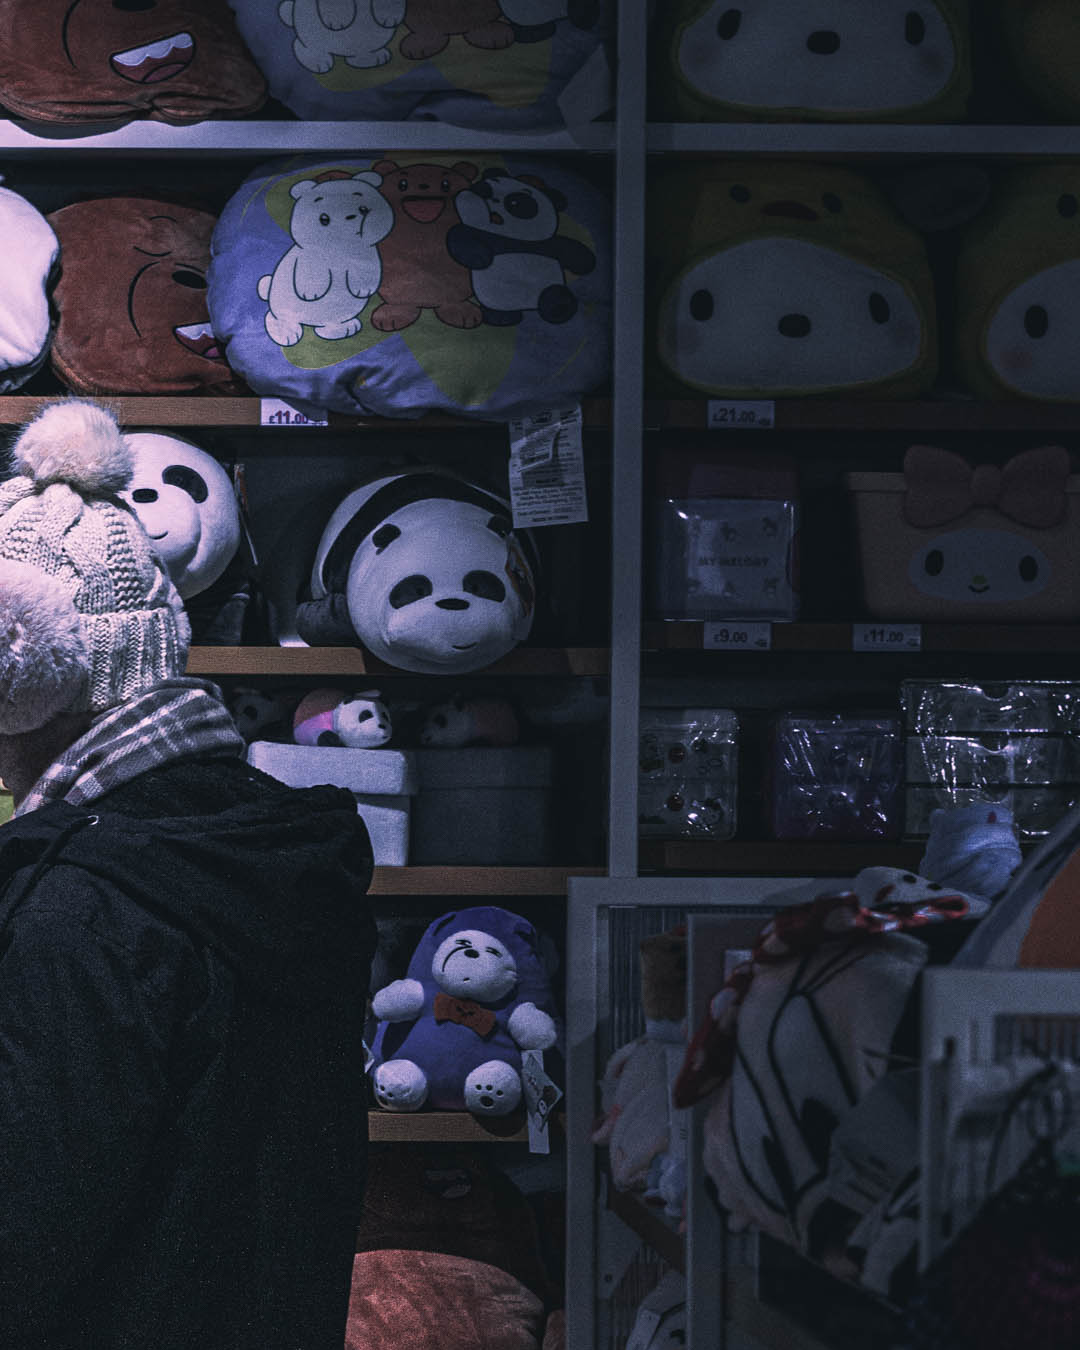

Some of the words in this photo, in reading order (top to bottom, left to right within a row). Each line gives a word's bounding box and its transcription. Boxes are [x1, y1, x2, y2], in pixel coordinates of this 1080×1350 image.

[712, 407, 756, 423] £21.00
[713, 628, 748, 642] £9.00
[863, 629, 905, 642] £11.00
